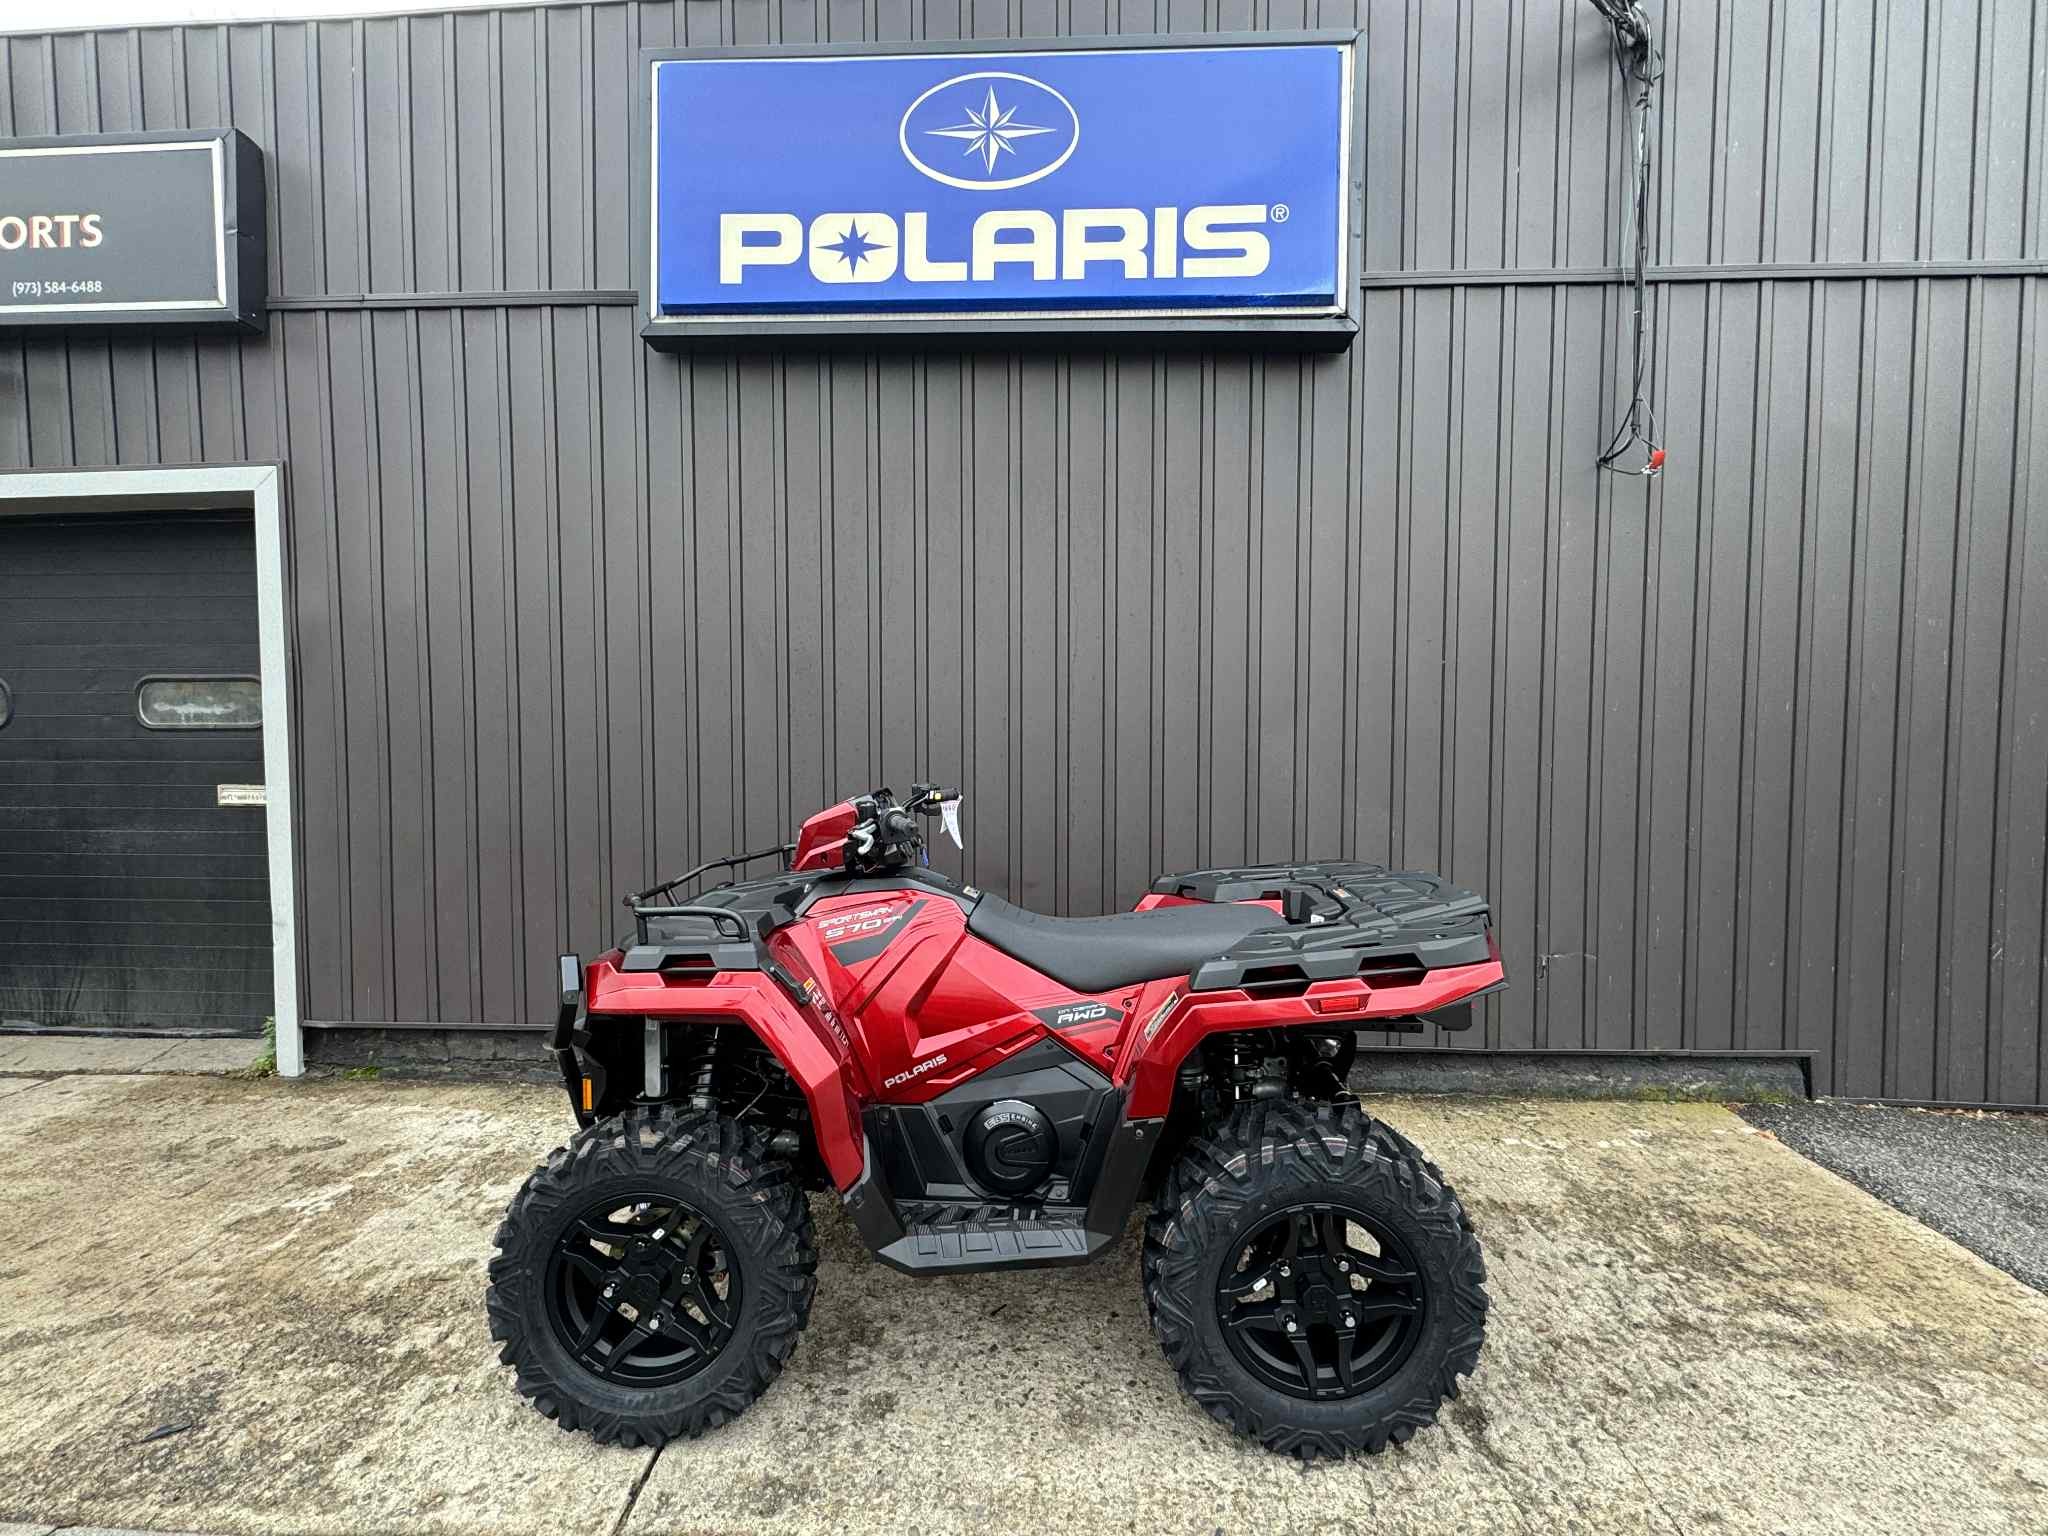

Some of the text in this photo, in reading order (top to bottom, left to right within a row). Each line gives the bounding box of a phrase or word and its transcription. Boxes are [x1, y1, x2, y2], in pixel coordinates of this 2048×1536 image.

[0, 214, 103, 250] ORTS
[12, 280, 103, 297] (973) 584-6488
[825, 919, 882, 939] 570
[1057, 1007, 1107, 1024] AWD
[884, 1053, 948, 1089] POLARIS
